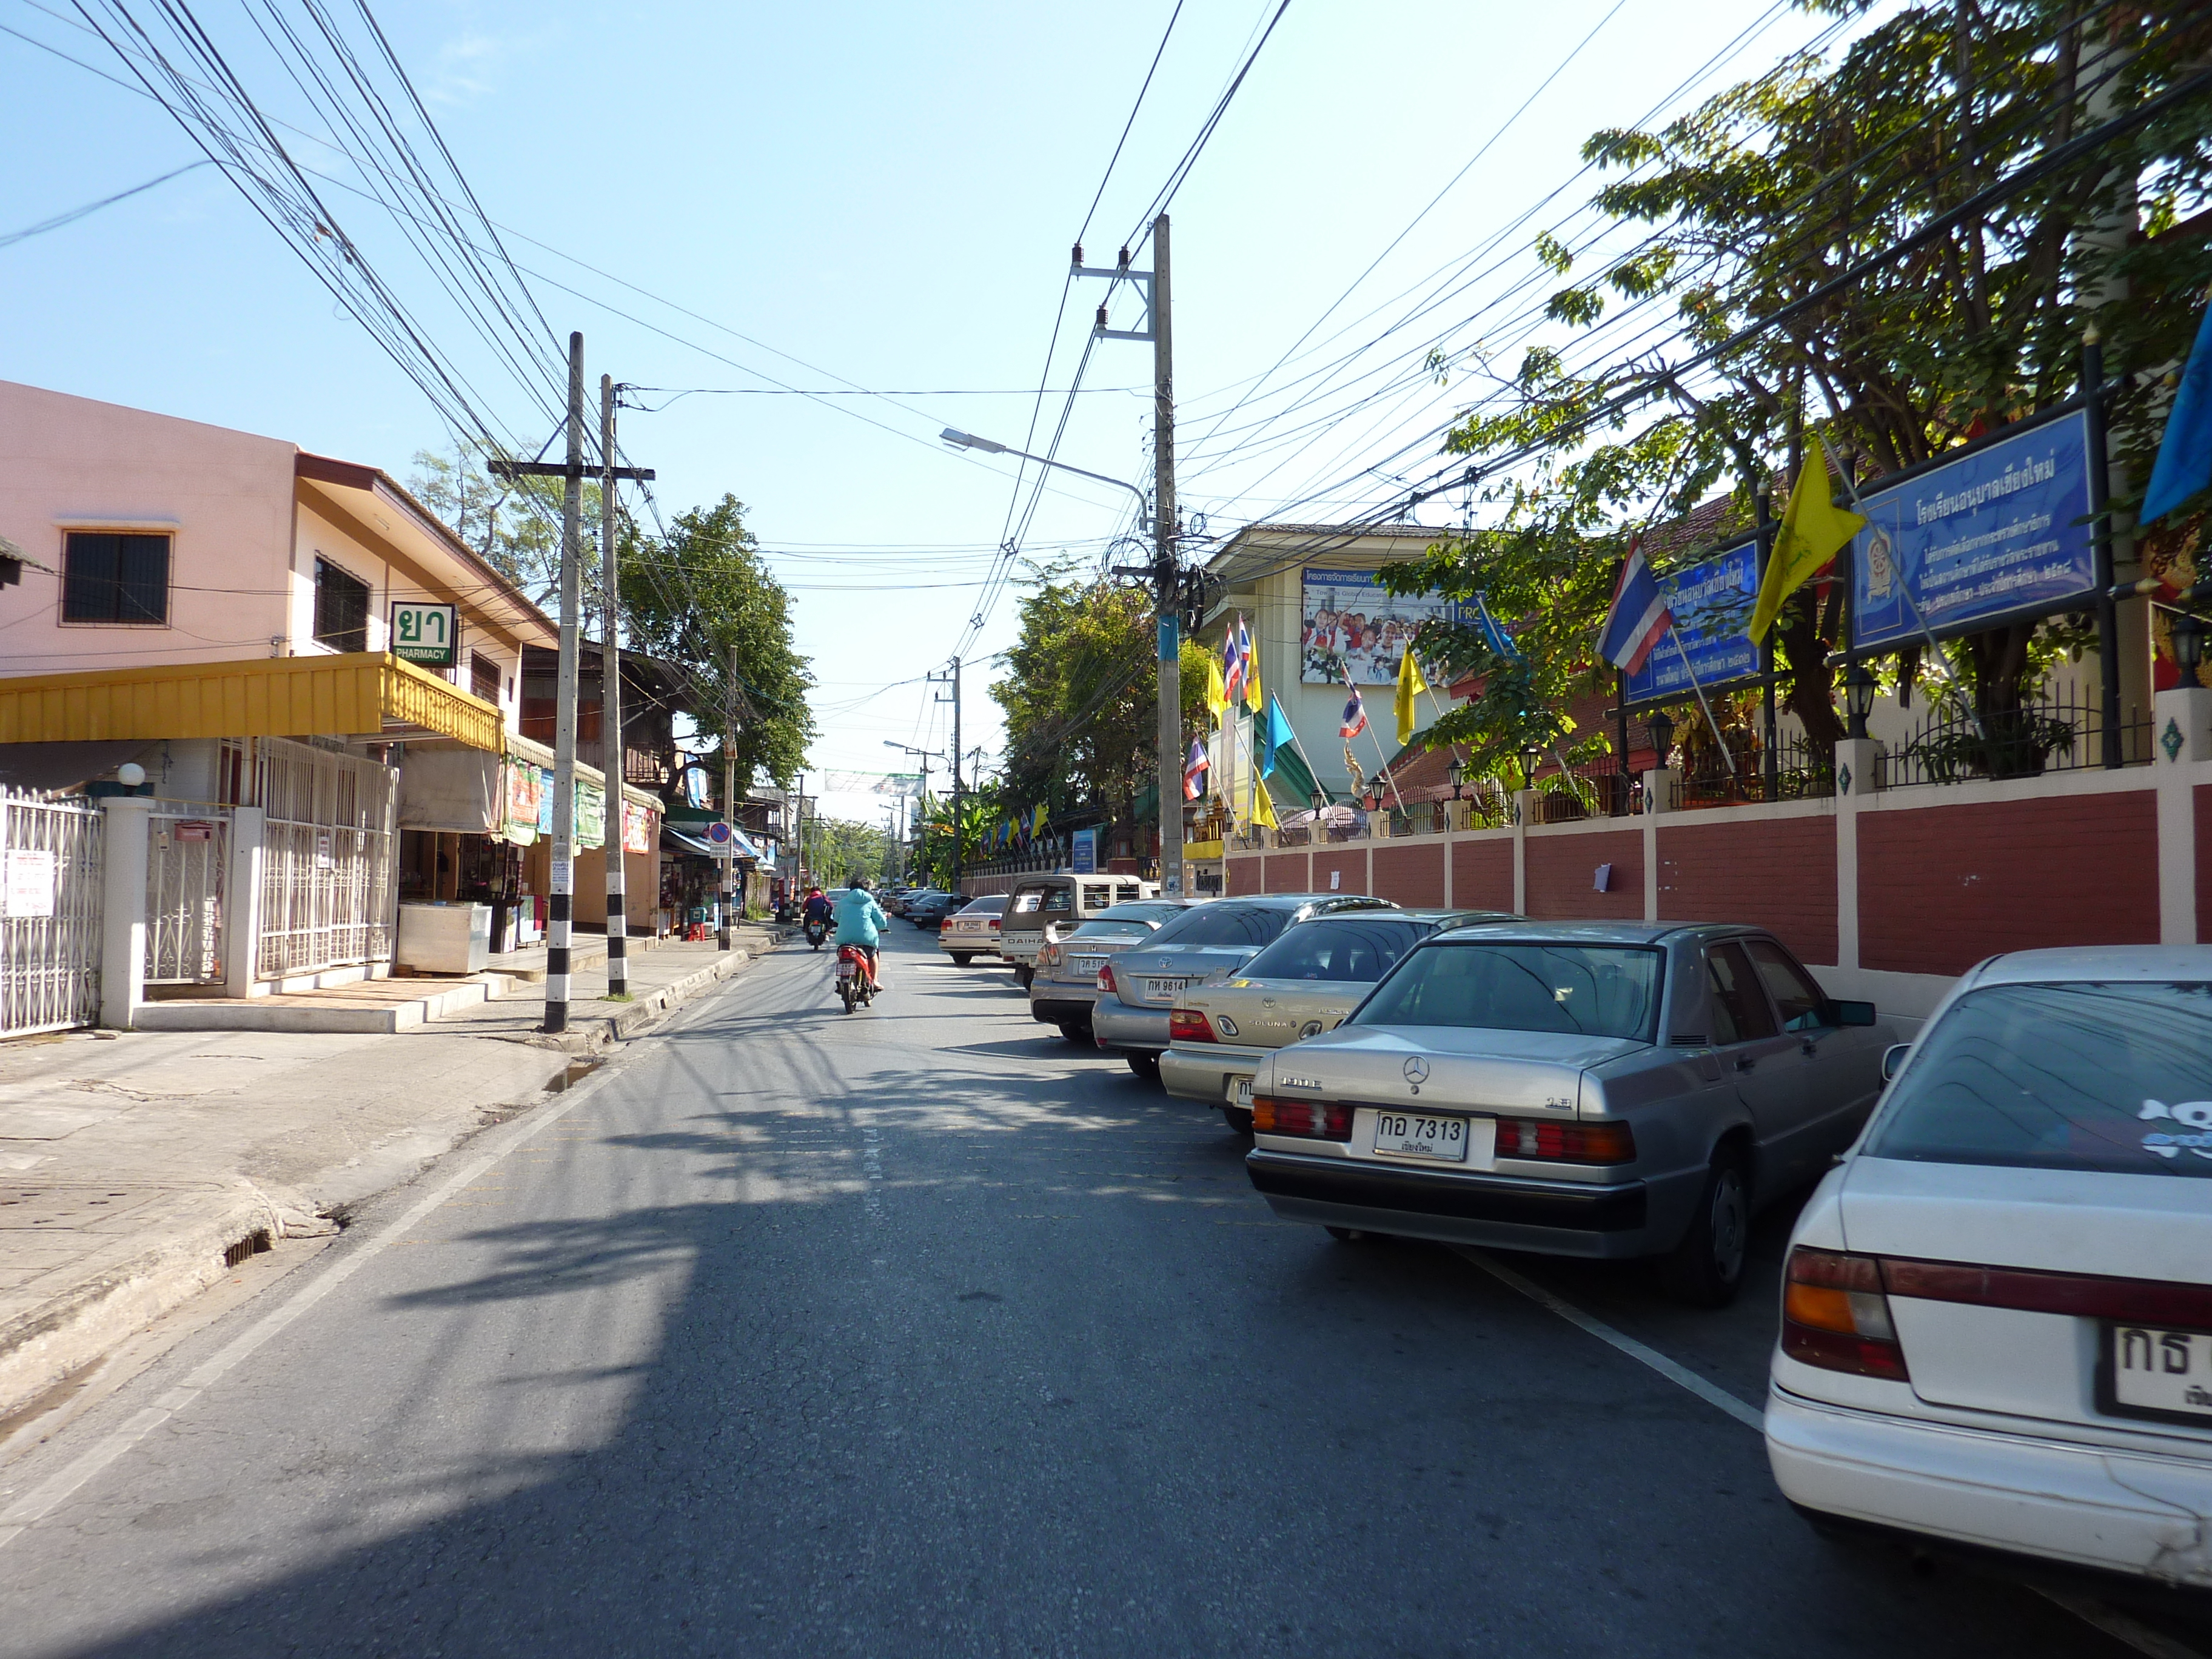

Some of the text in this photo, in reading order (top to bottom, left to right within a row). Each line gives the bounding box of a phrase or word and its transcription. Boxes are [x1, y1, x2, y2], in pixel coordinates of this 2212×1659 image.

[399, 610, 444, 643] ยา
[396, 648, 446, 660] PHARMACY
[1163, 981, 1183, 992] 9614
[1380, 1116, 1461, 1141] กอ 7313
[1401, 1141, 1433, 1153] เชียงใหม่
[2123, 1329, 2191, 1375] กธ
